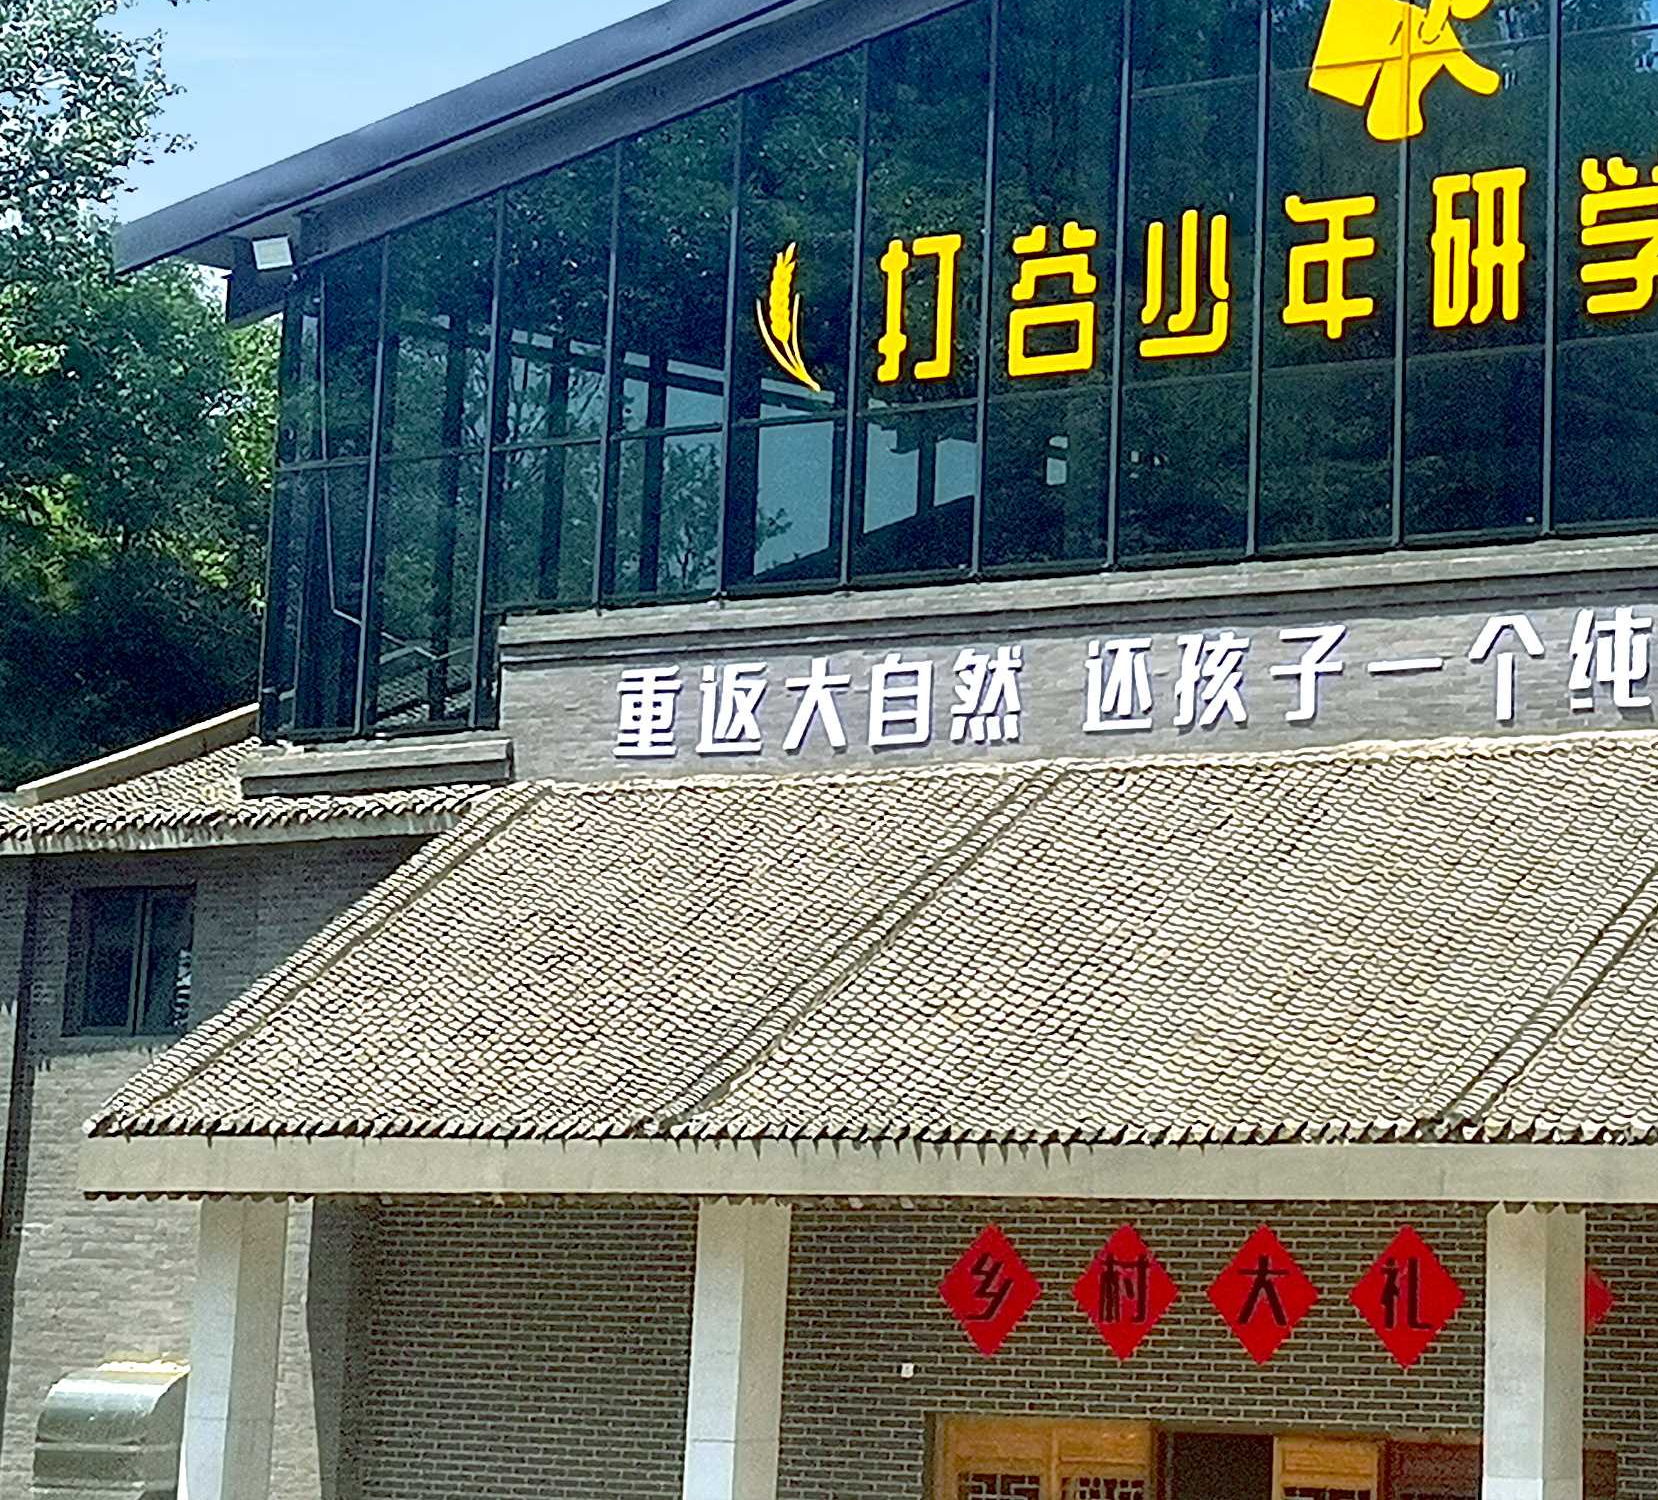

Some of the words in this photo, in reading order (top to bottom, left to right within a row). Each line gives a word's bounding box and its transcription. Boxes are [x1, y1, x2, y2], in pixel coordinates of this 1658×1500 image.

[612, 646, 1024, 759] 重返大自然
[964, 1251, 1435, 1332] 乡村大礼
